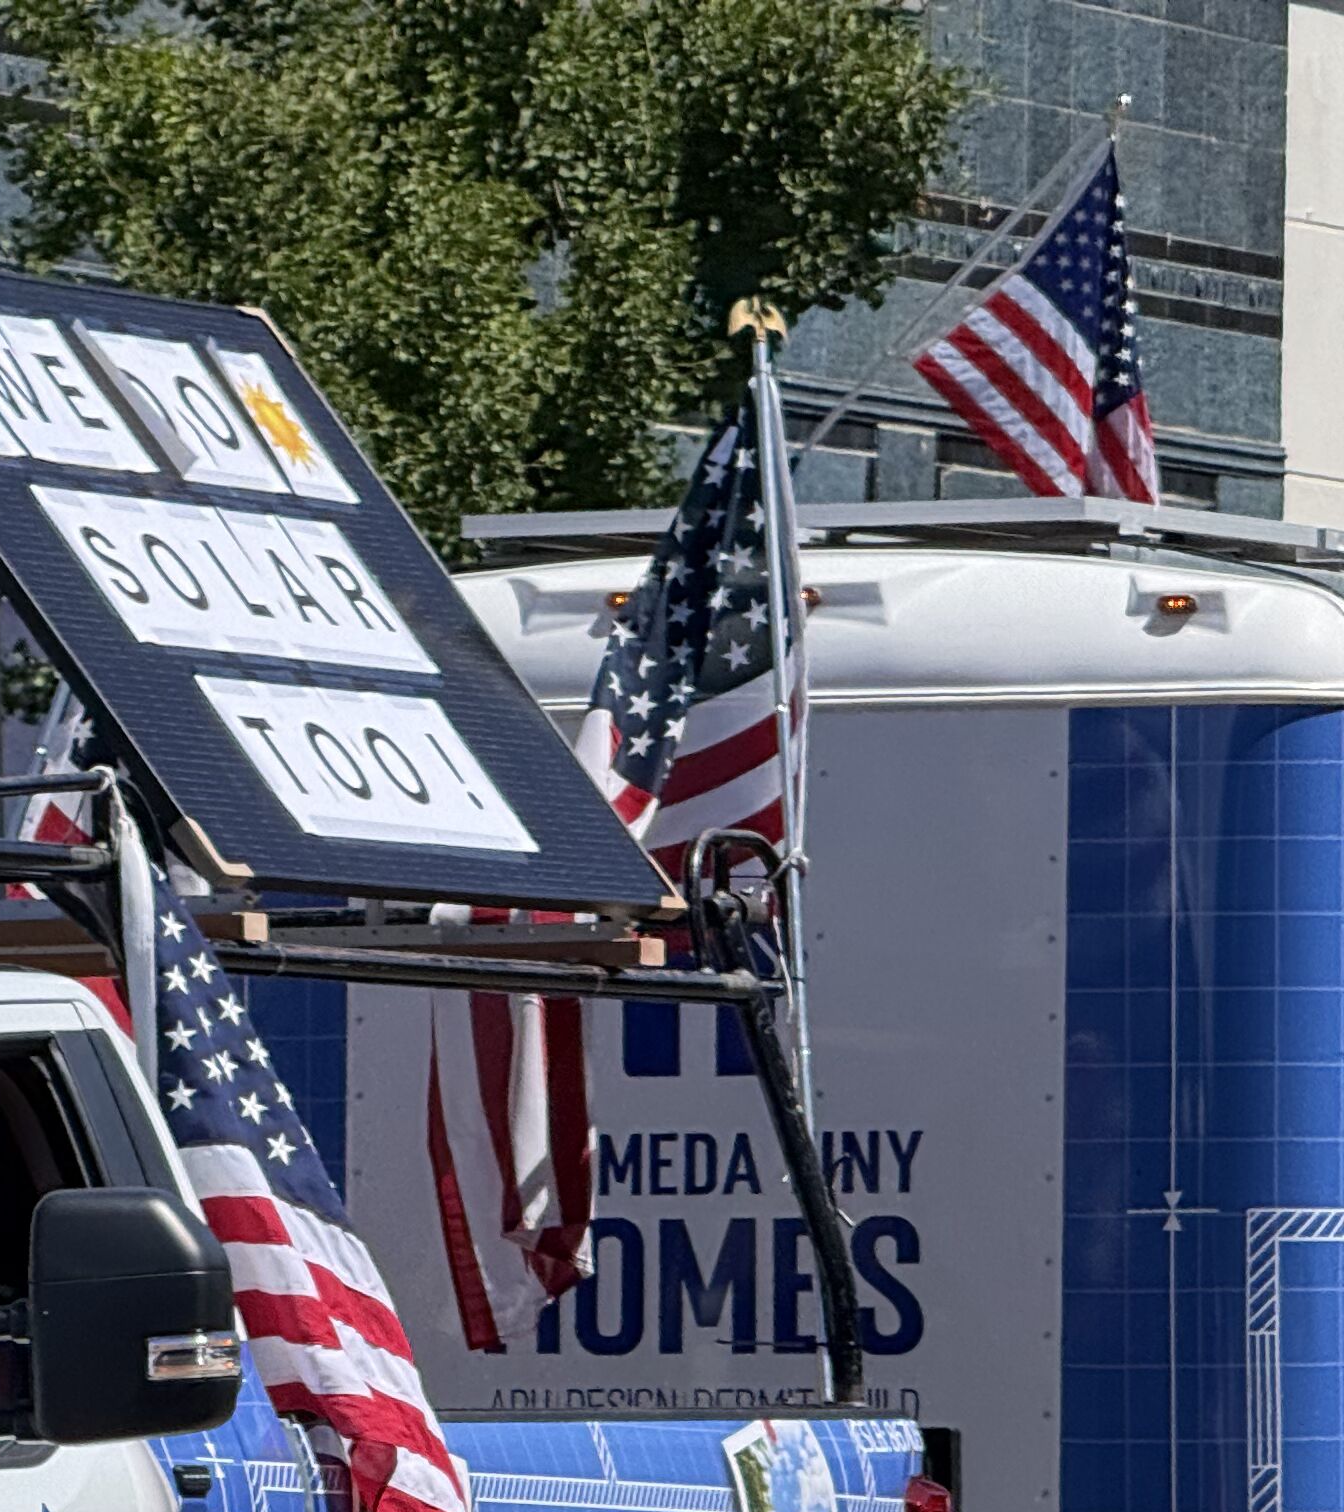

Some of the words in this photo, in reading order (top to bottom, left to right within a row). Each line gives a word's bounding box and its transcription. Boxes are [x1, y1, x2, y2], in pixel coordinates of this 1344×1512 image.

[81, 526, 396, 632] SOLAR
[238, 715, 484, 811] TOO!
[484, 1215, 925, 1356] OMES
